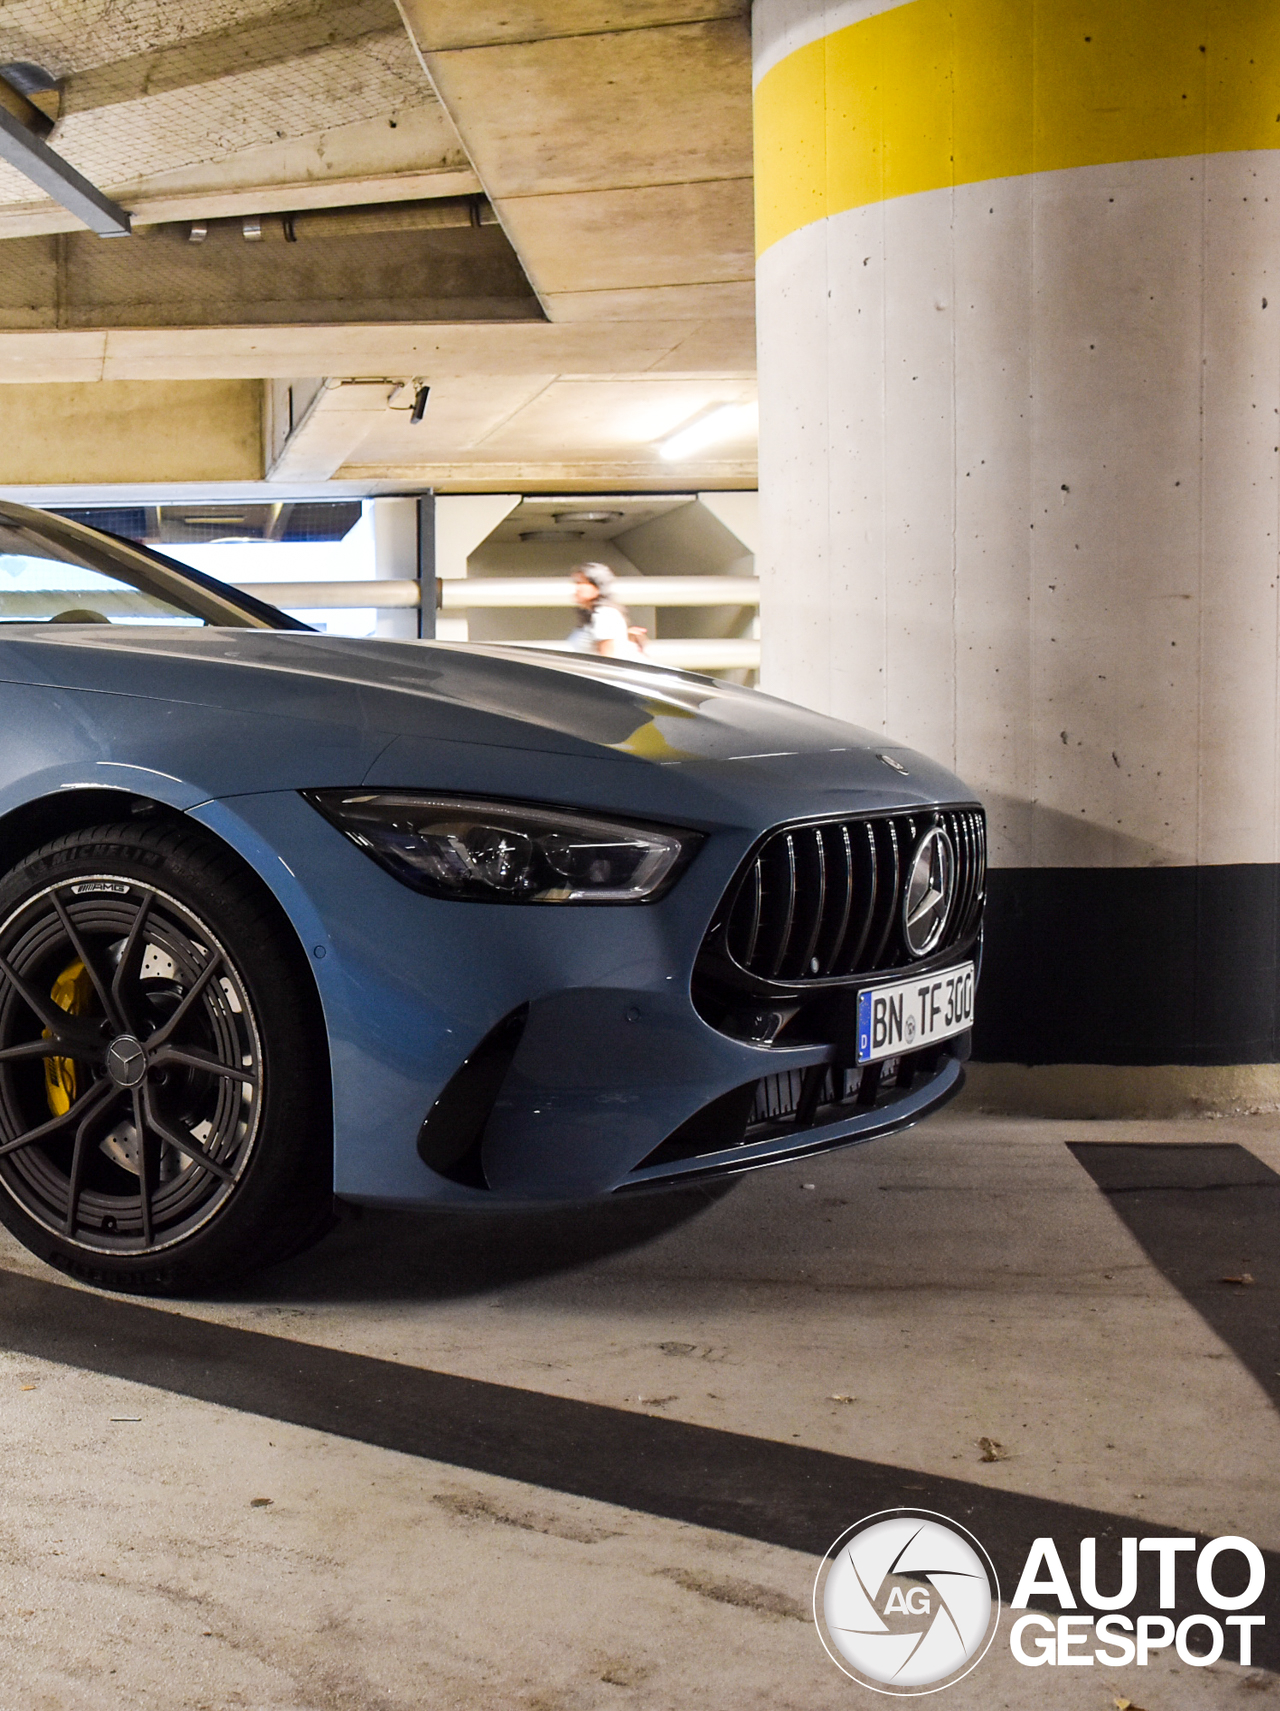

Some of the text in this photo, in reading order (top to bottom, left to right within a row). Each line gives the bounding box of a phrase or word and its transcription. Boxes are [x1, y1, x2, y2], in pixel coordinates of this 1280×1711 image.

[52, 844, 160, 867] MICHELIN
[93, 883, 125, 892] AMG
[873, 973, 971, 1048] BN TF 300
[861, 1034, 867, 1049] D
